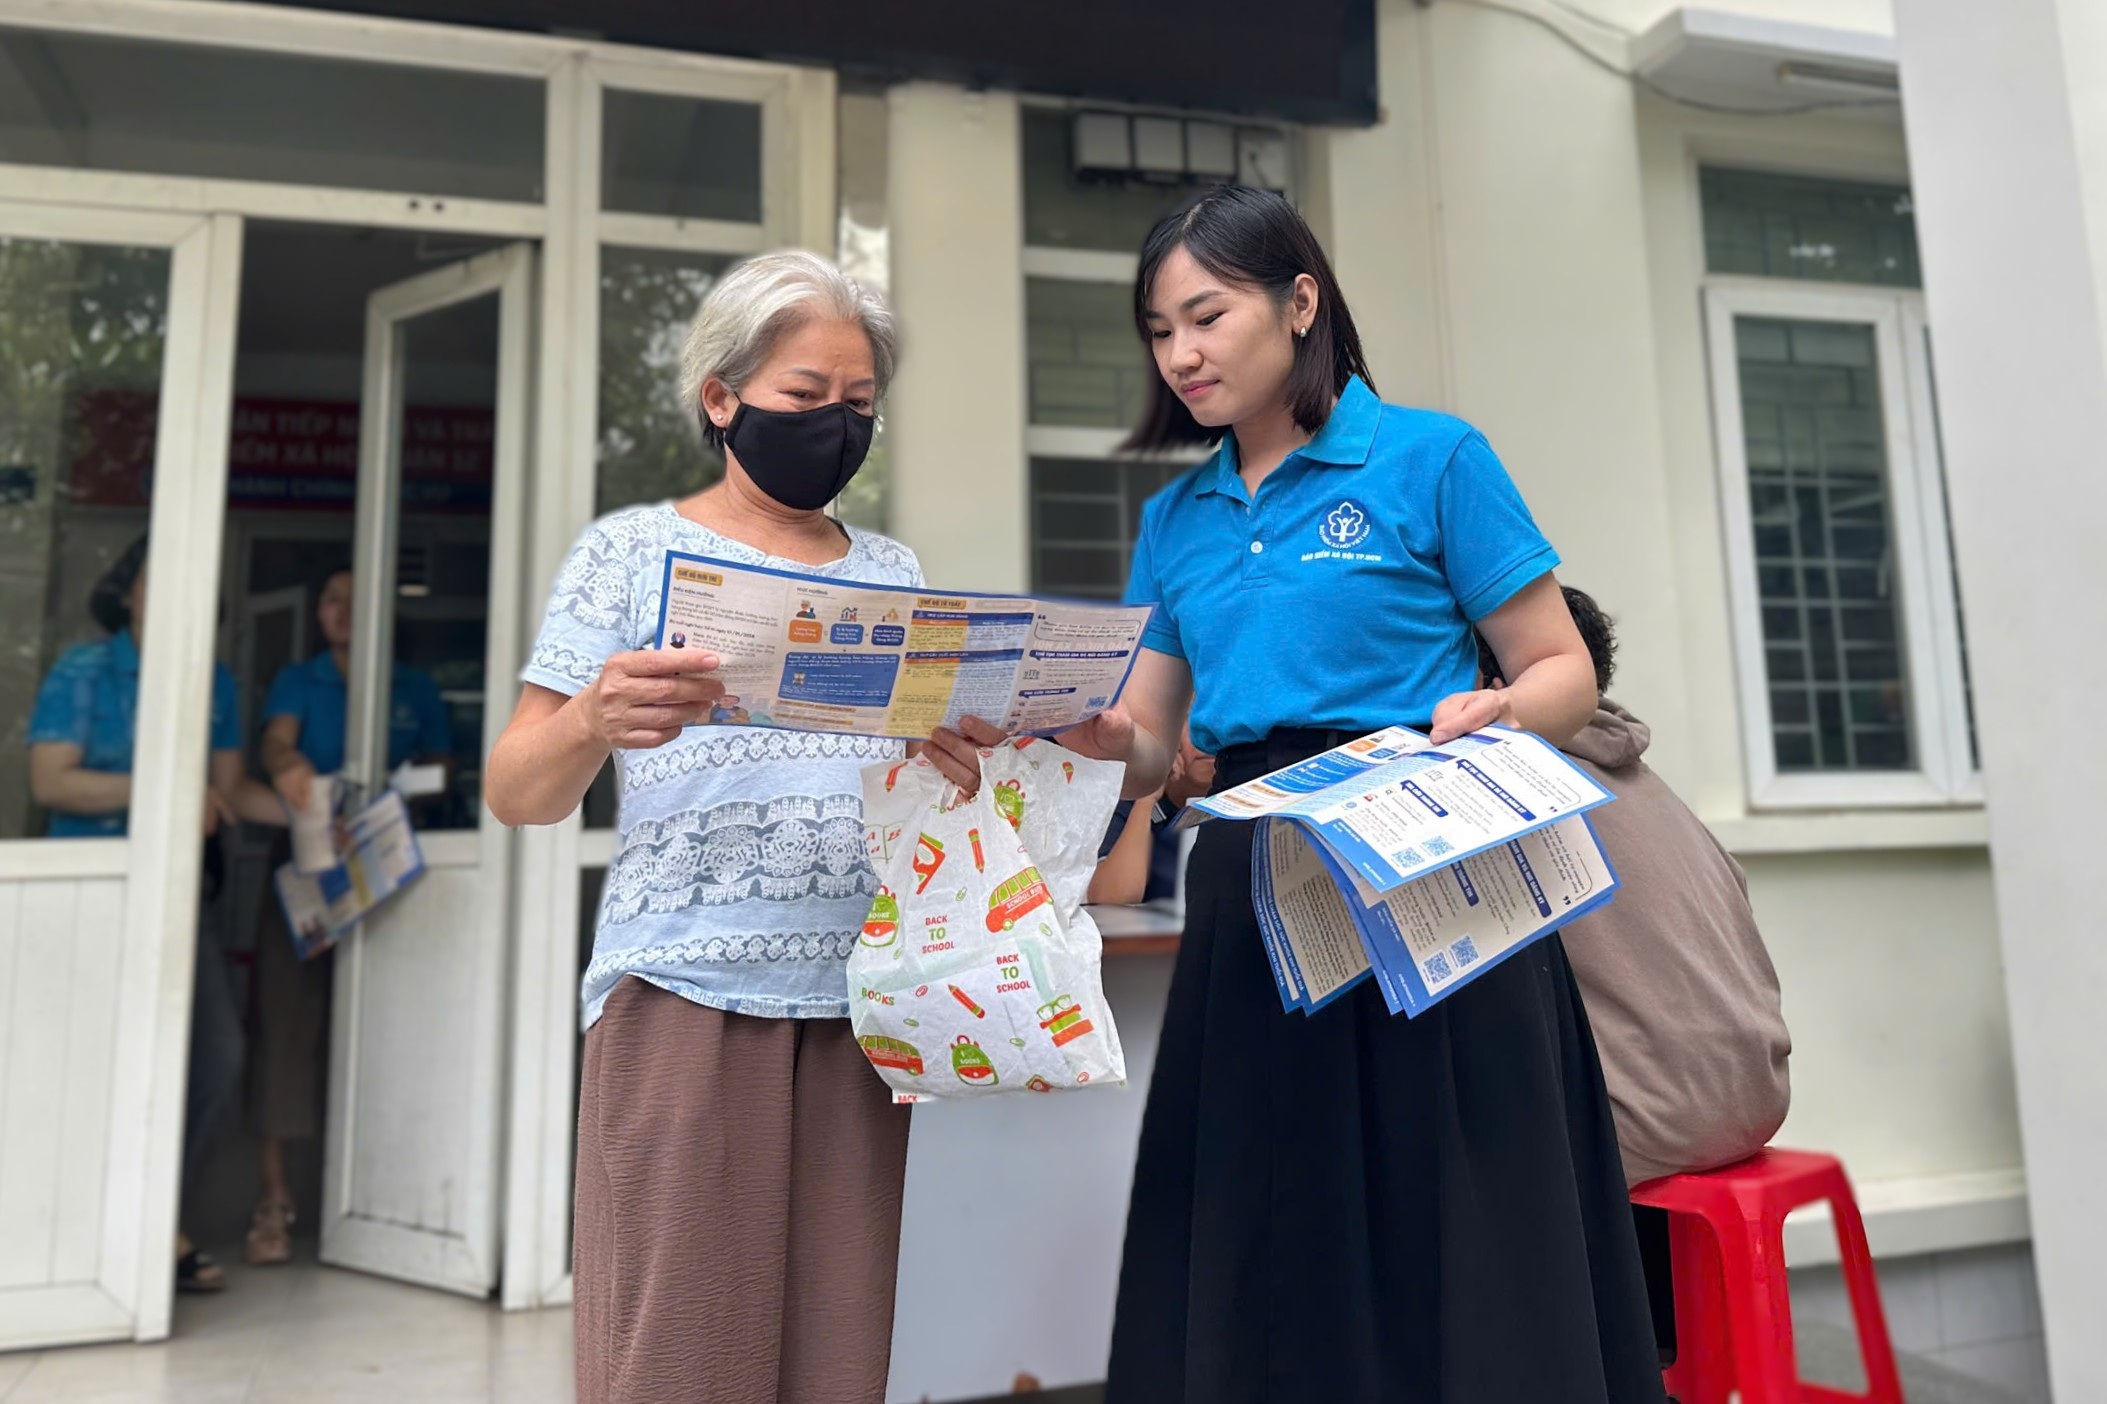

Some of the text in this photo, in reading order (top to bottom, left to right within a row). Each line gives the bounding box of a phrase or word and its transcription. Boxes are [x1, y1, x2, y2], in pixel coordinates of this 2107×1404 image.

[1006, 891, 1030, 909] SCHOOL
[925, 914, 948, 926] BACK
[928, 927, 946, 941] TO
[922, 941, 955, 954] SCHOOL
[996, 953, 1020, 965] BACK
[1000, 966, 1019, 980] TO
[996, 980, 1032, 993] SCHOOL
[861, 986, 895, 1006] BOOKS
[897, 1094, 918, 1104] BACK
